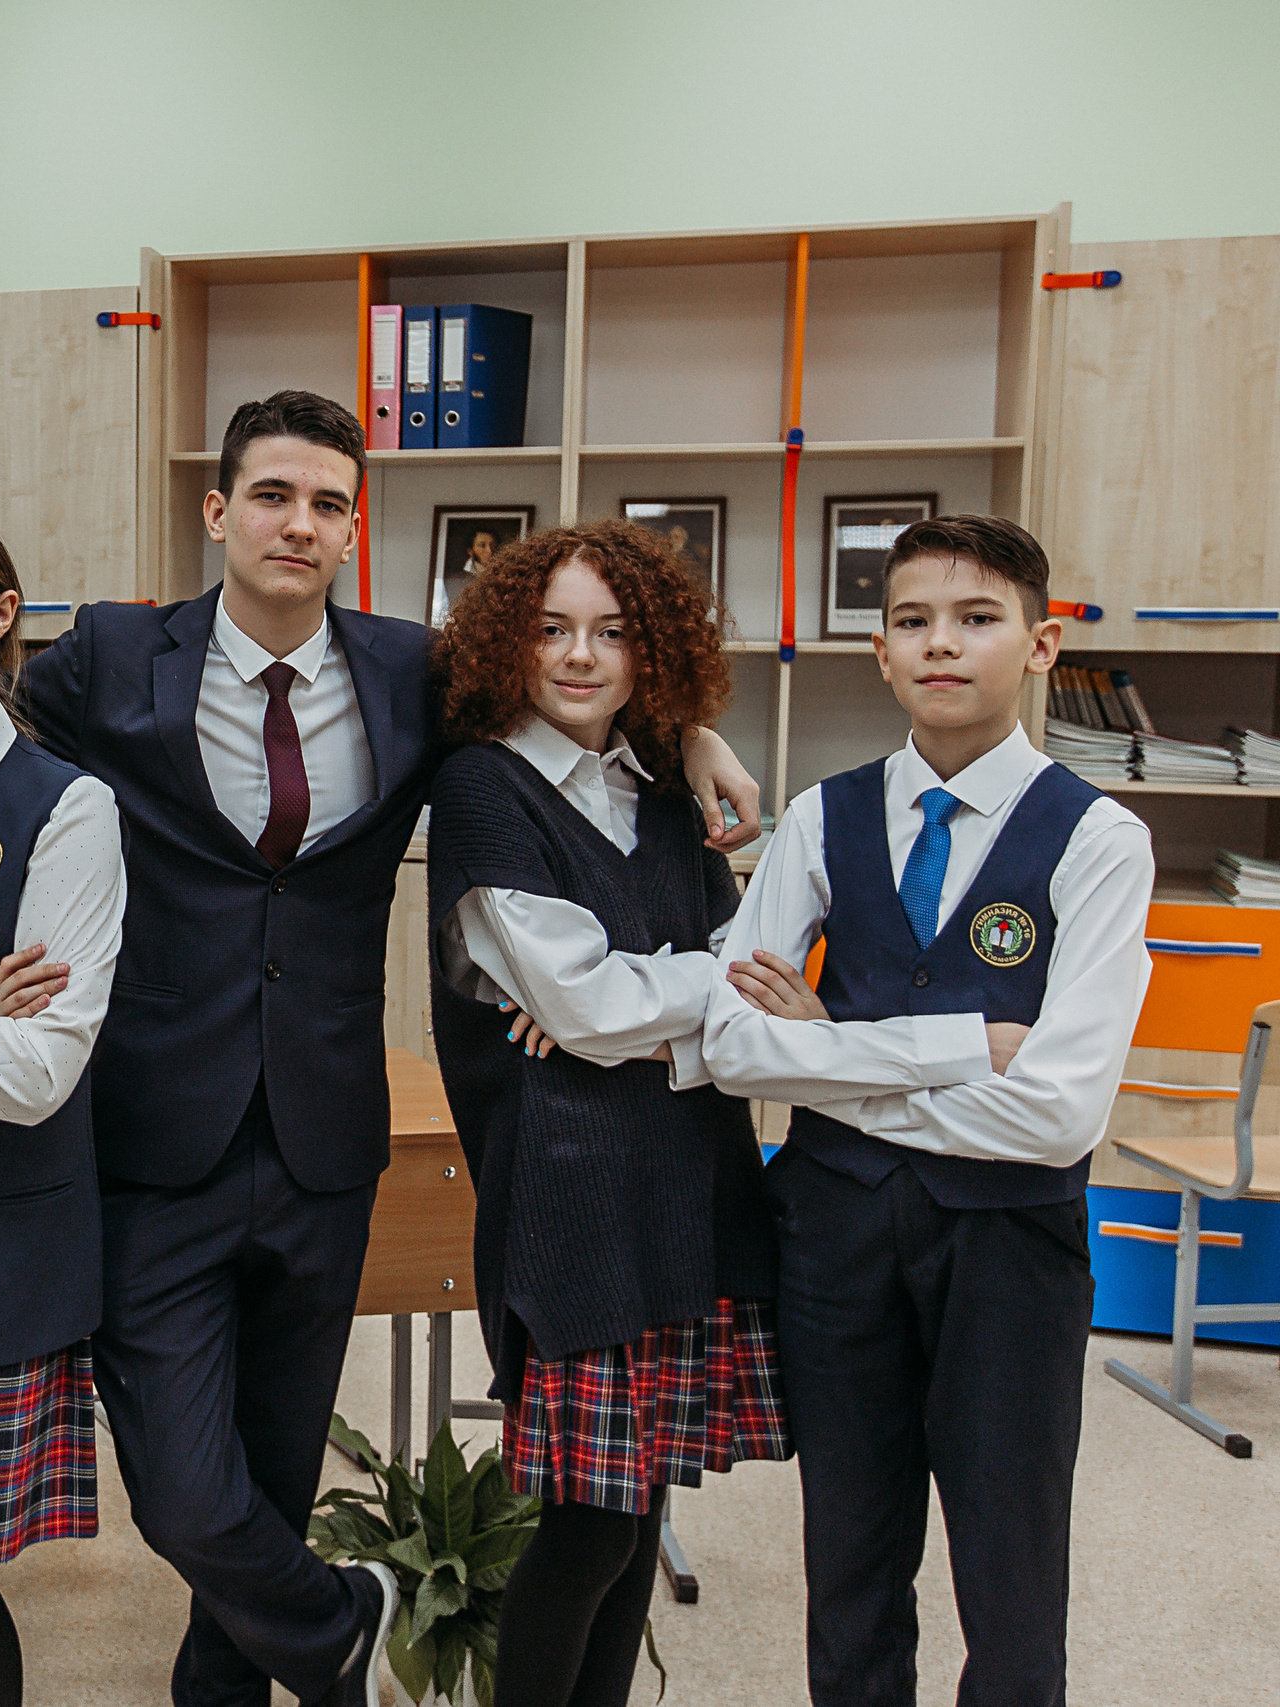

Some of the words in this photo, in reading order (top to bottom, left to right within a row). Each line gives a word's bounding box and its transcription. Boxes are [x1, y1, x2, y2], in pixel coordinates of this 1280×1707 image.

[976, 908, 1018, 930] ГИМНАЗИЯ
[1018, 916, 1027, 927] №
[1024, 928, 1030, 939] 16
[987, 952, 1019, 962] Тюмень
